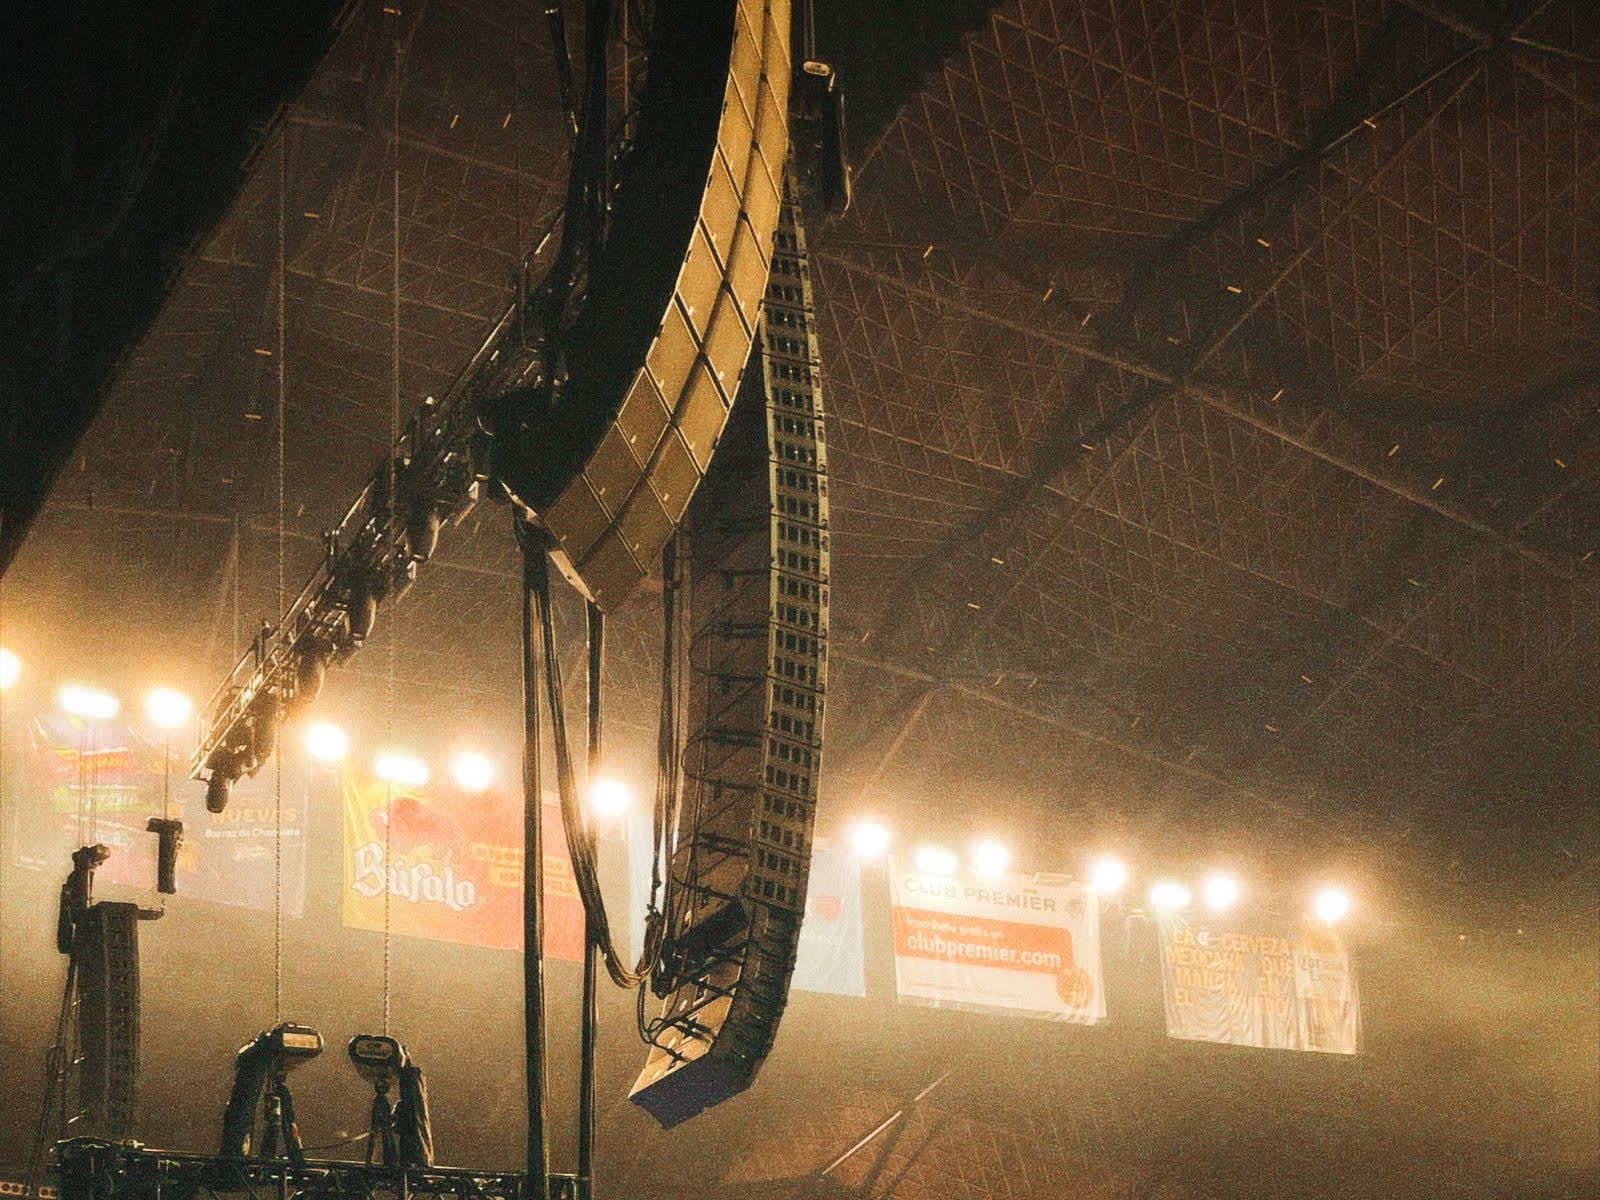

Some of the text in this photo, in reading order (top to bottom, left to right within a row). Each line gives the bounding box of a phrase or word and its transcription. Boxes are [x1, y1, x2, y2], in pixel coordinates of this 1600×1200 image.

[904, 877, 1057, 912] CLUB PREMIER
[906, 933, 1062, 968] clubpremier.com
[1173, 926, 1291, 956] LA CERVEZA
